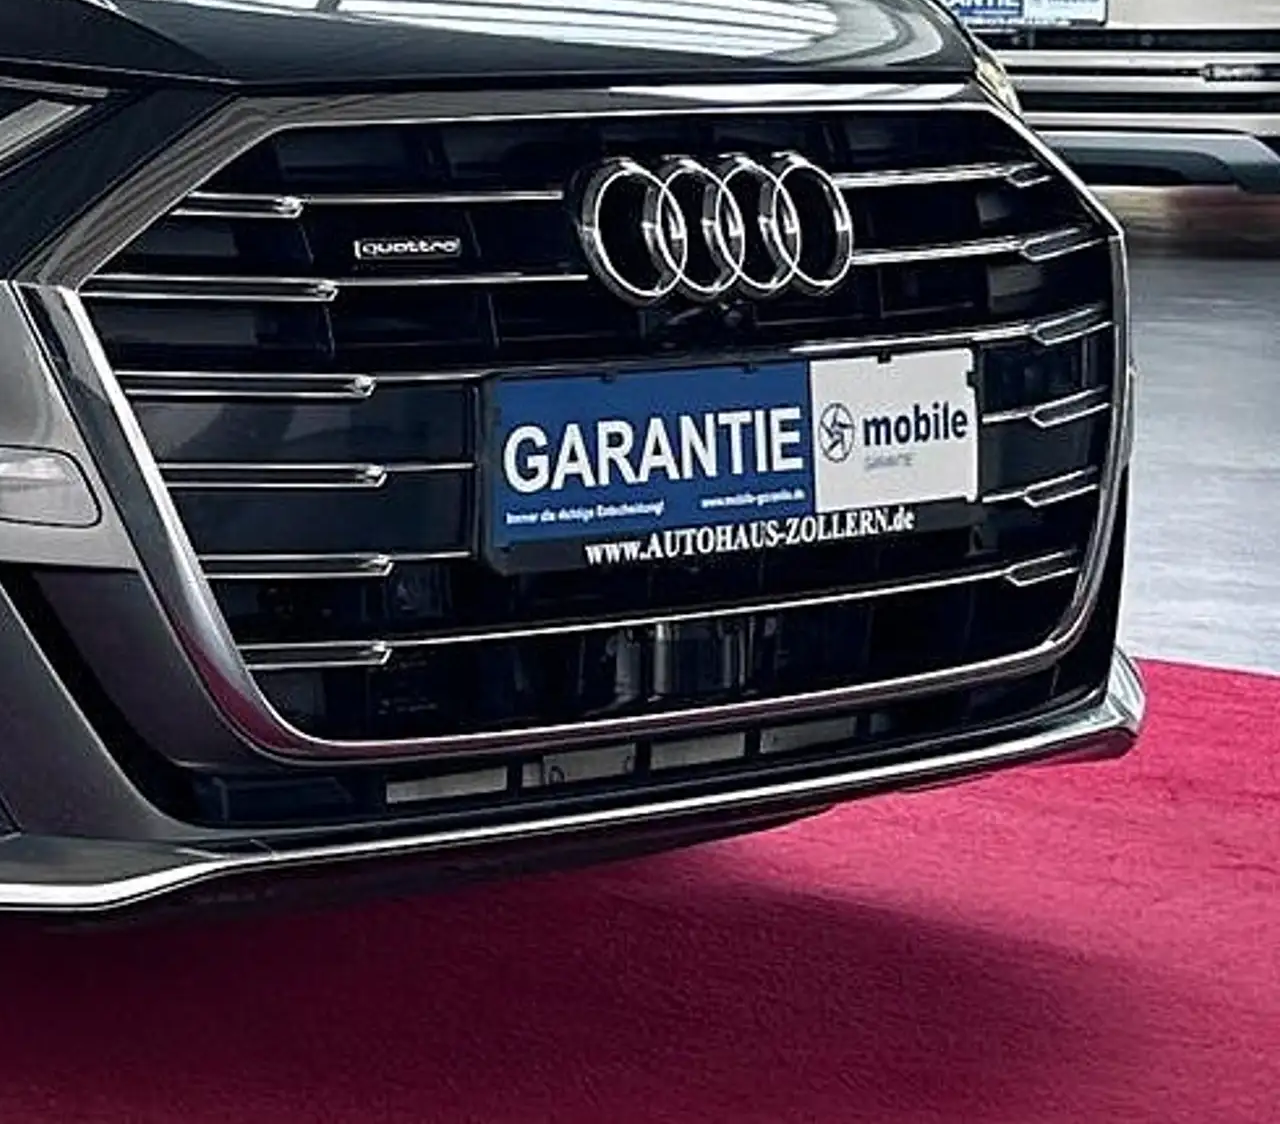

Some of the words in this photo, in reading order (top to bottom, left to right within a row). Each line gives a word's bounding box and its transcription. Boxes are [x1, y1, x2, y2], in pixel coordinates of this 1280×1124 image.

[362, 240, 458, 256] quattro
[502, 406, 804, 494] GARANTIE
[861, 401, 969, 447] mobile
[585, 505, 916, 566] www.AUTOHAUS-ZOLLERN.de
